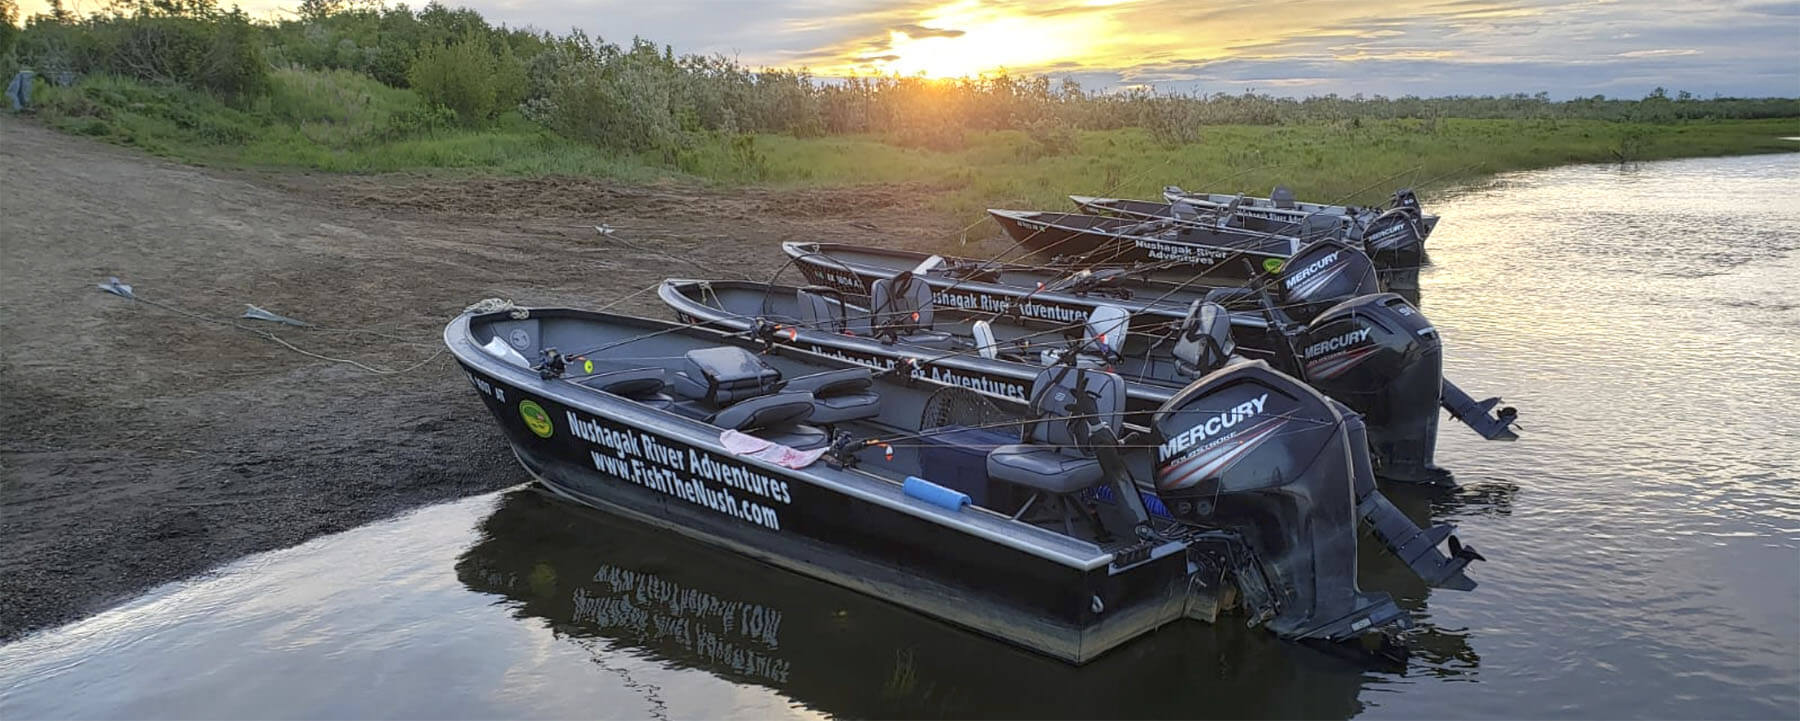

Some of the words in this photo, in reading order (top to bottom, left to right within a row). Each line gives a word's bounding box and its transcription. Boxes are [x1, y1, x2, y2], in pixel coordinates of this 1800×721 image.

[1135, 240, 1192, 255] Nushagak
[1148, 249, 1214, 265] Adventures
[1286, 251, 1339, 289] MERCURY
[933, 292, 977, 309] shagak
[1304, 327, 1371, 360] MERCURY
[931, 367, 1026, 399] Adventures
[1160, 393, 1268, 462] MERCURY
[566, 410, 642, 459] Nushagak
[641, 433, 685, 471] River
[689, 448, 792, 504] Adventures
[590, 450, 780, 531] www.FishTheNush.com
